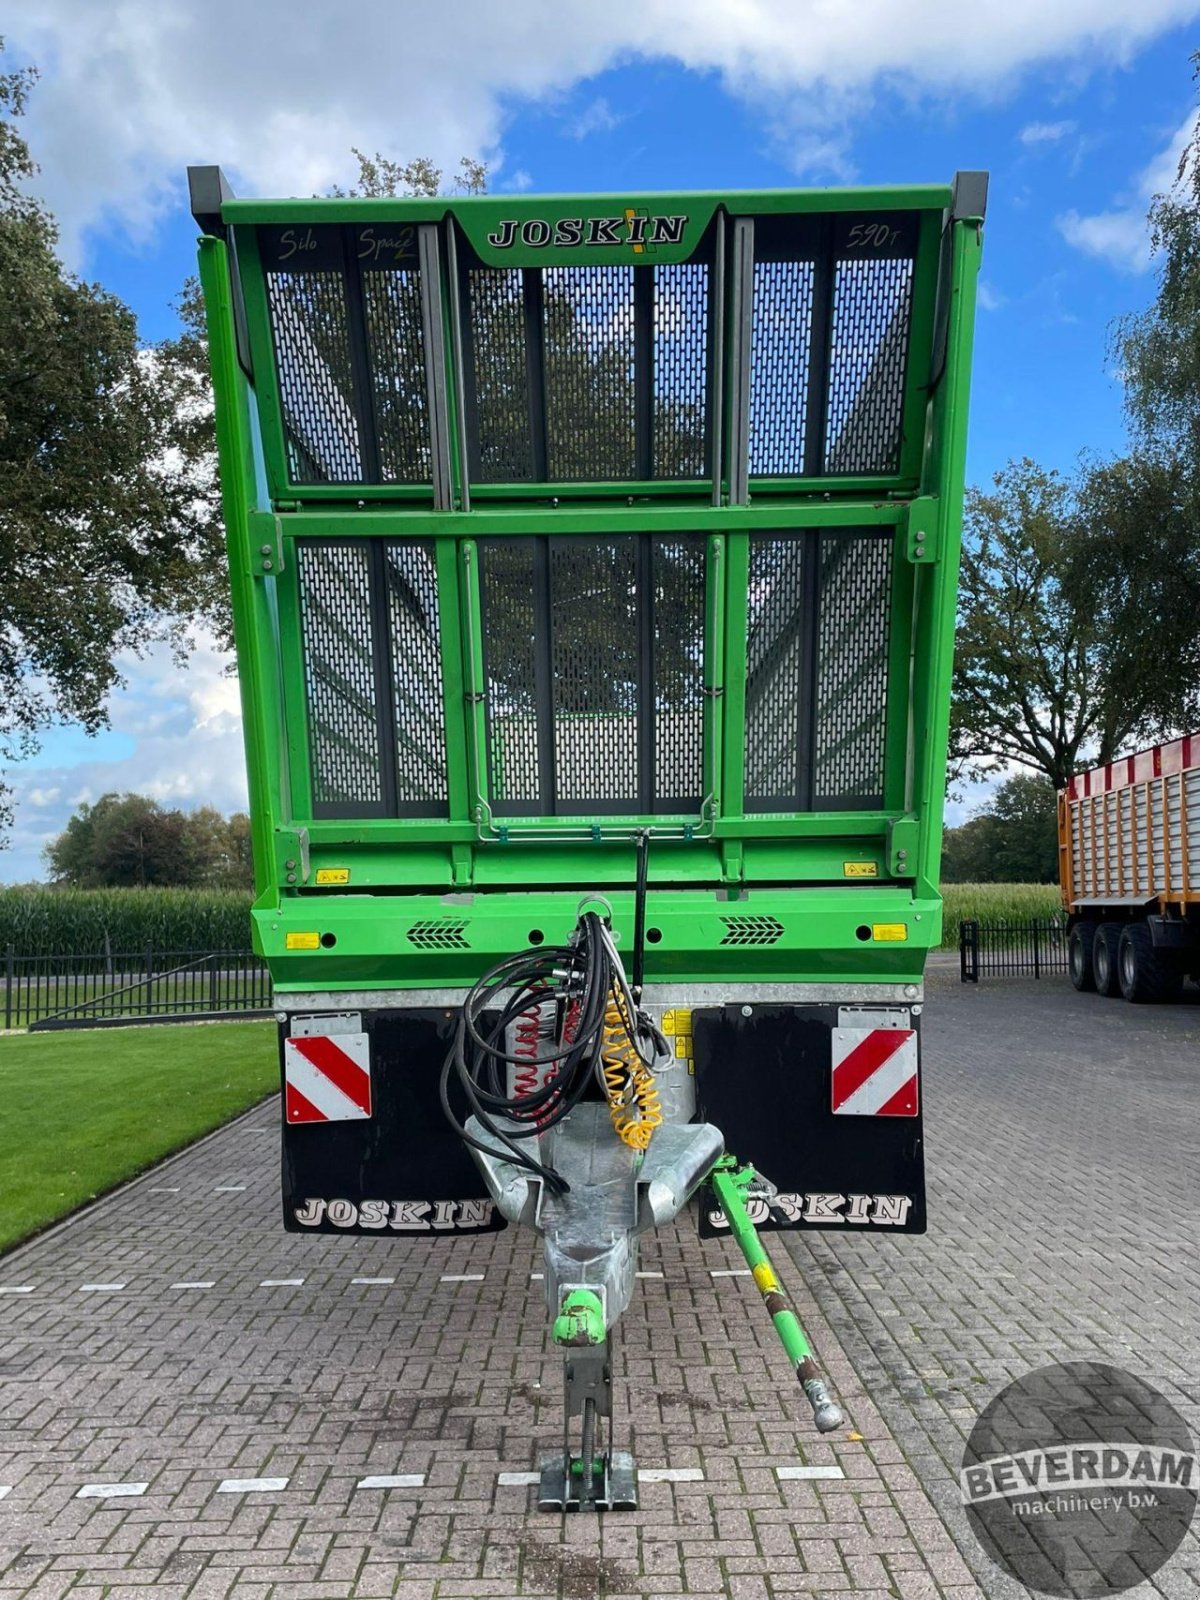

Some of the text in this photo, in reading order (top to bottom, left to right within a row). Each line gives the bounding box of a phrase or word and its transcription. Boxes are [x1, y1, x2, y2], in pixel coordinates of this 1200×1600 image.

[278, 228, 317, 260] Silo
[487, 214, 689, 248] JOSKIN
[294, 1198, 496, 1229] JOSKIN
